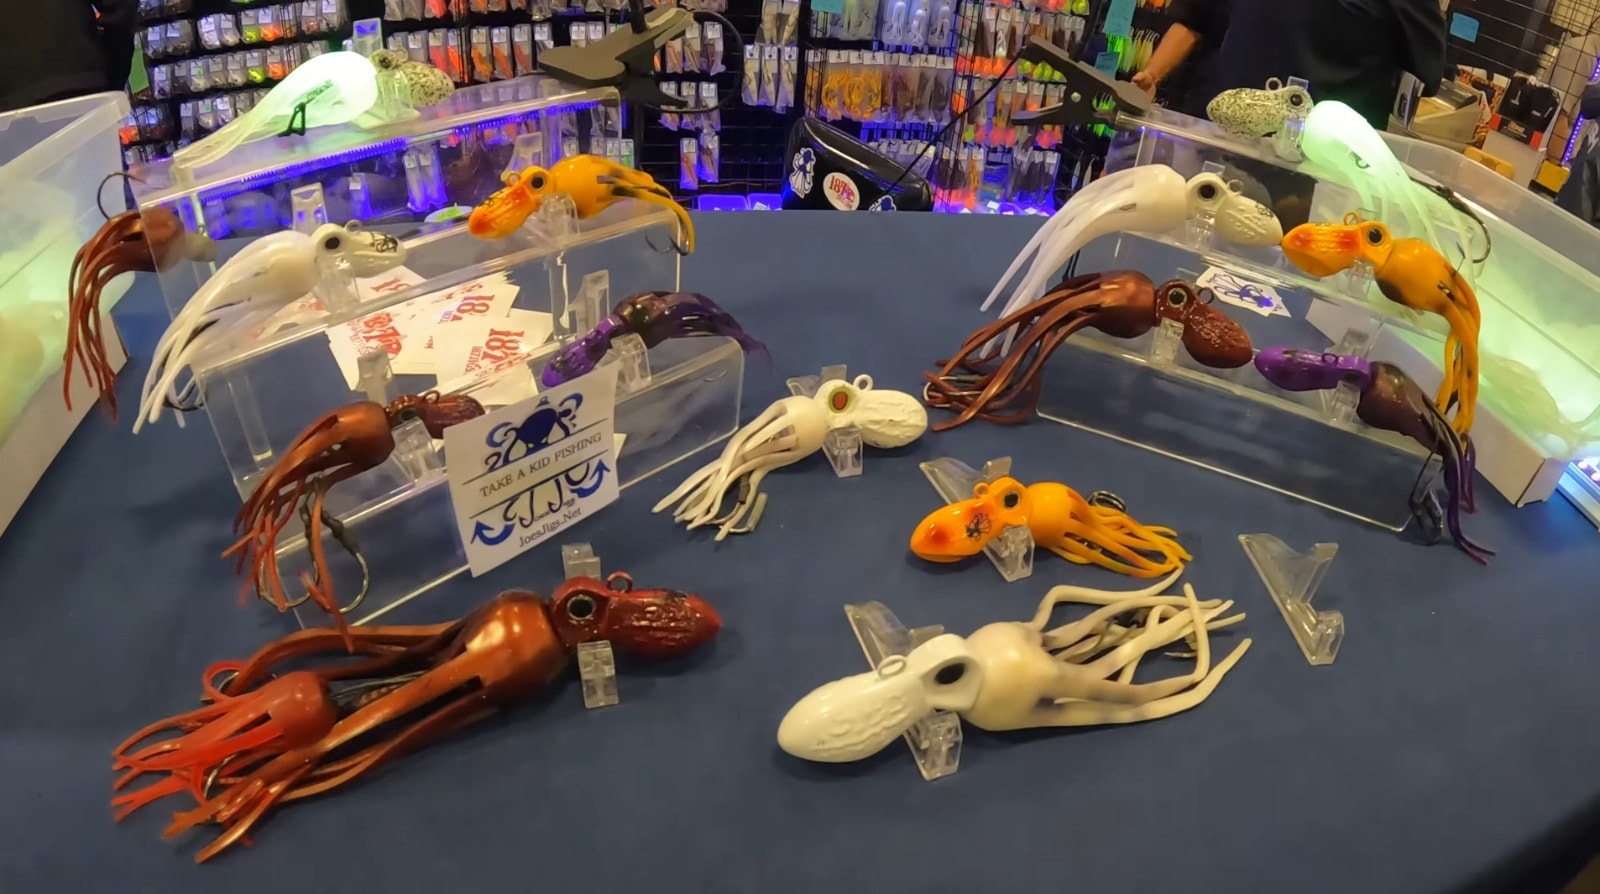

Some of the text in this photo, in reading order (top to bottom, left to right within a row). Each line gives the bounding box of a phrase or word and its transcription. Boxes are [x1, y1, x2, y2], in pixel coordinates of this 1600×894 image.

[480, 432, 602, 498] TAKE A KID FISHING
[519, 507, 582, 547] JoesJigs.Net
